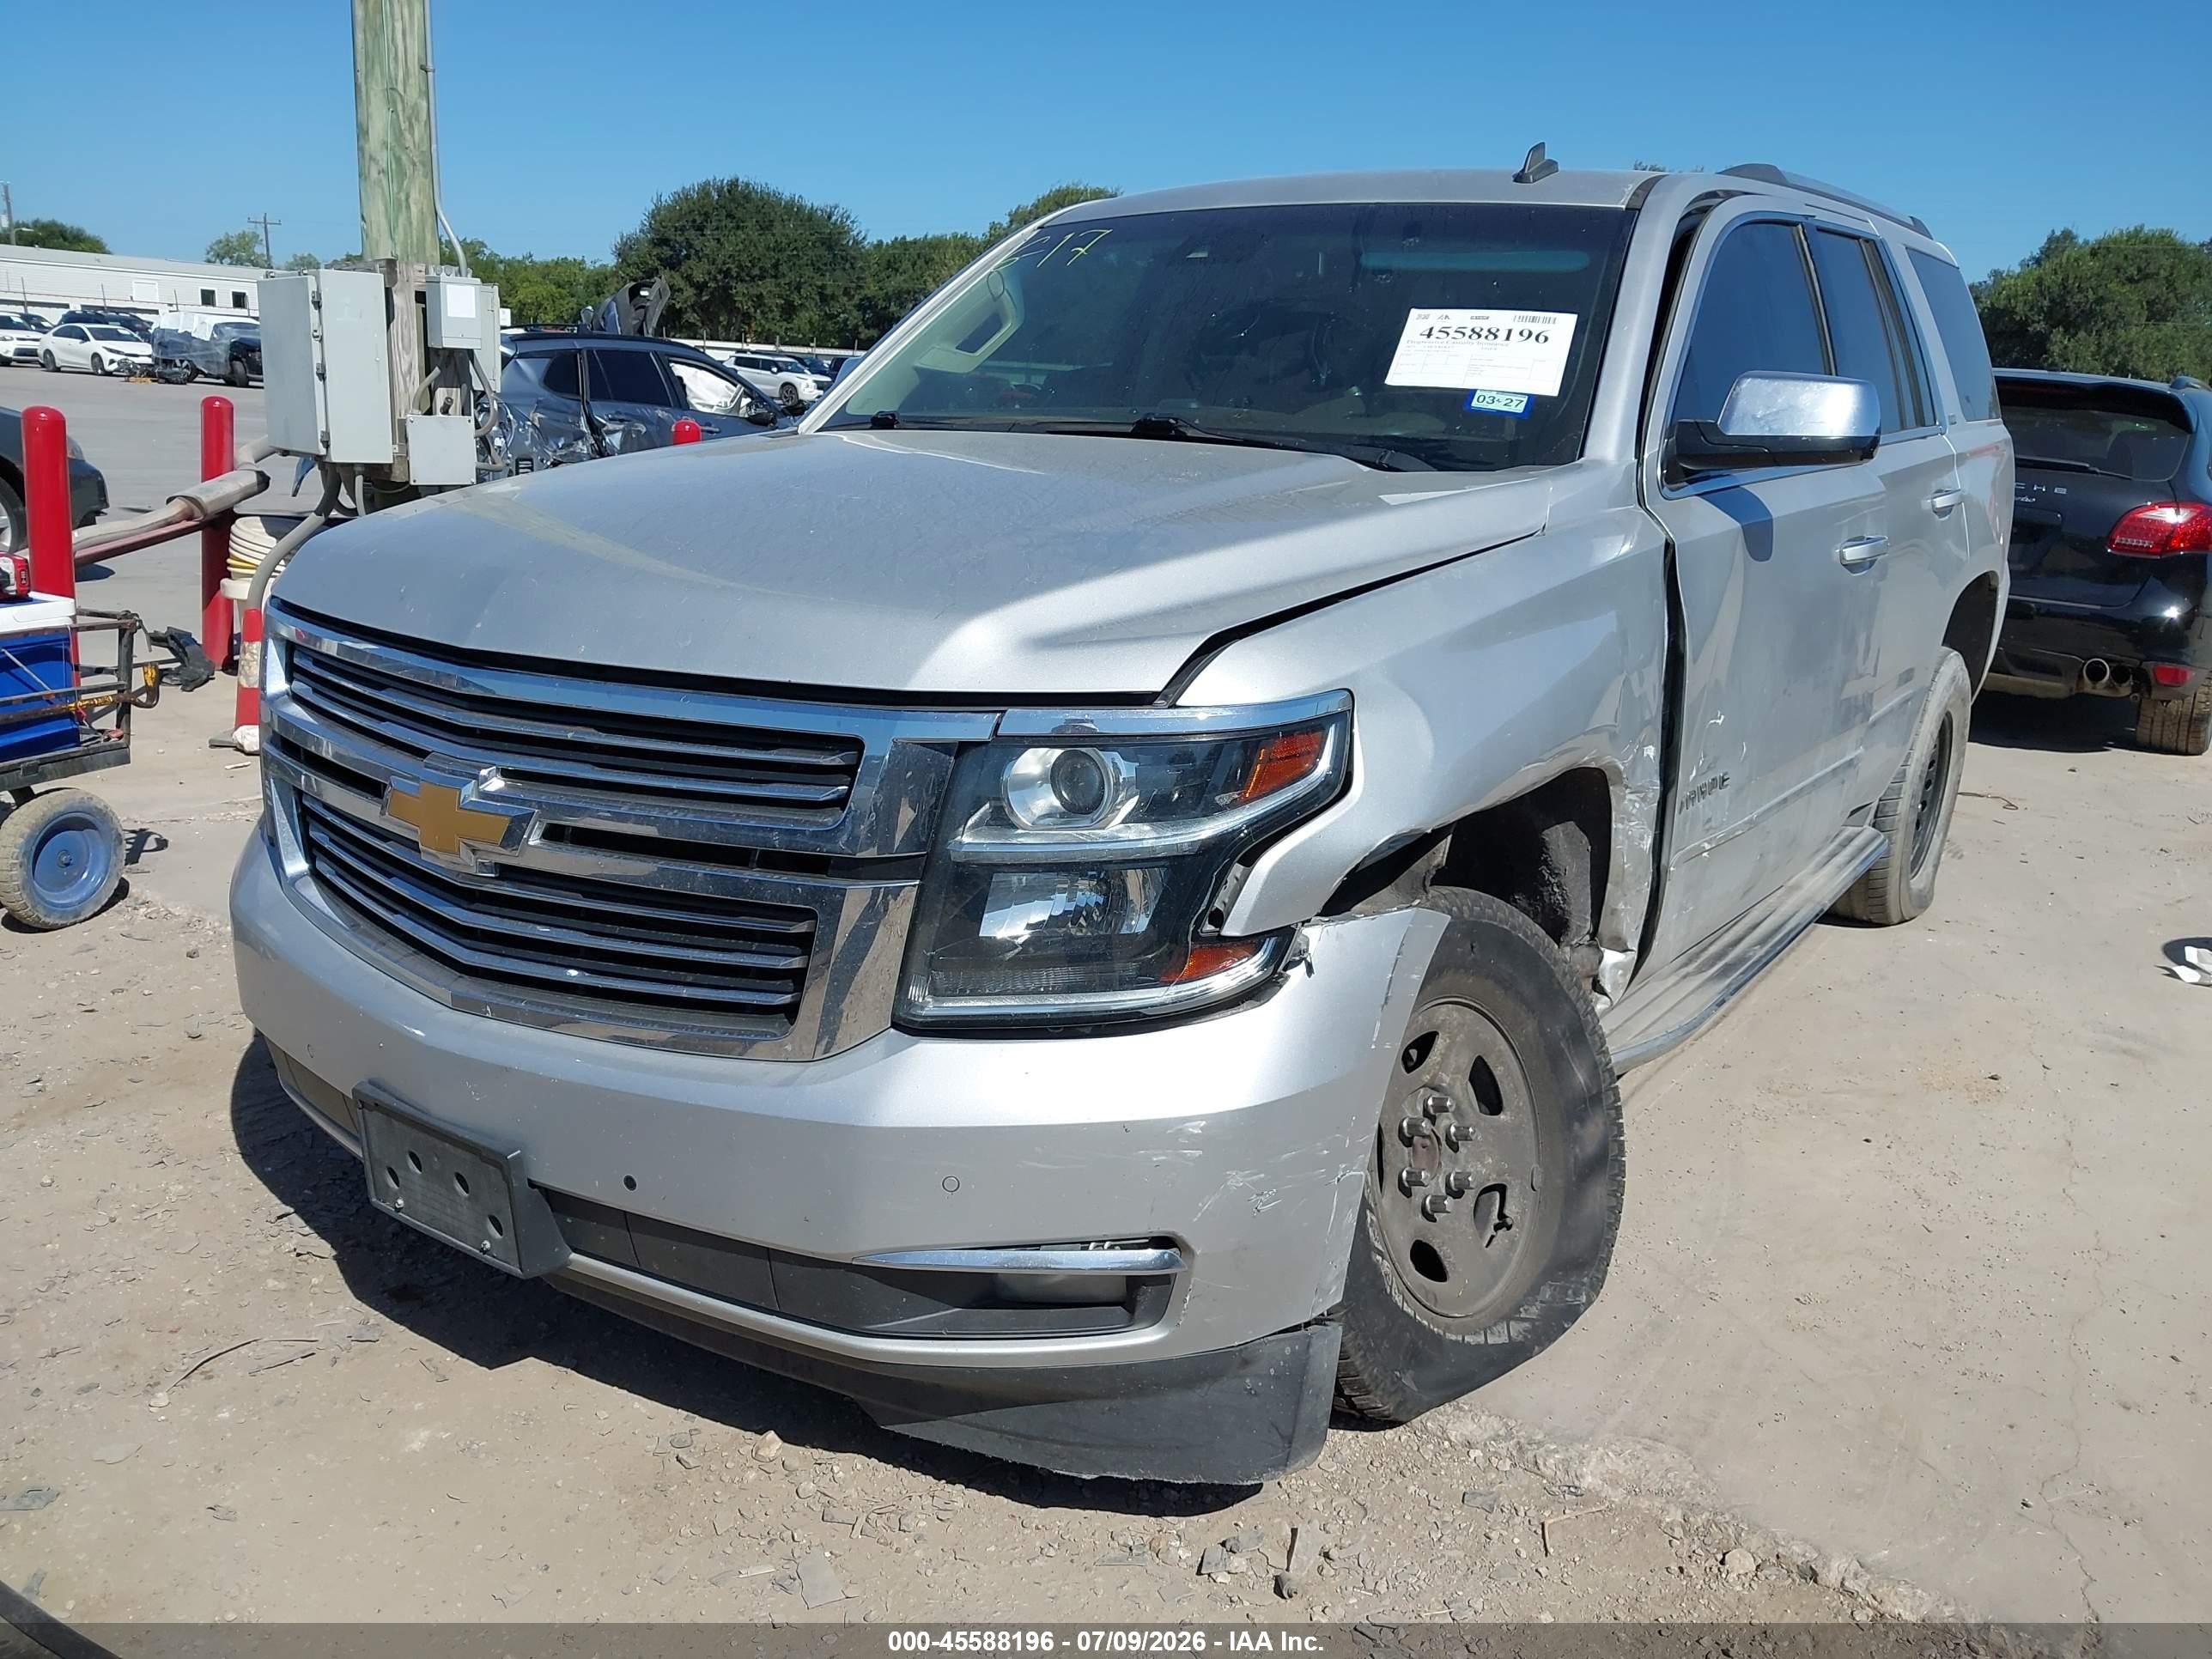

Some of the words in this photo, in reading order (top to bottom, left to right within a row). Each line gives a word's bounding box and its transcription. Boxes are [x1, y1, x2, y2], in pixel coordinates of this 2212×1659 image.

[1419, 325, 1552, 344] 45588196
[1476, 394, 1496, 405] 03
[1503, 398, 1525, 408] 27
